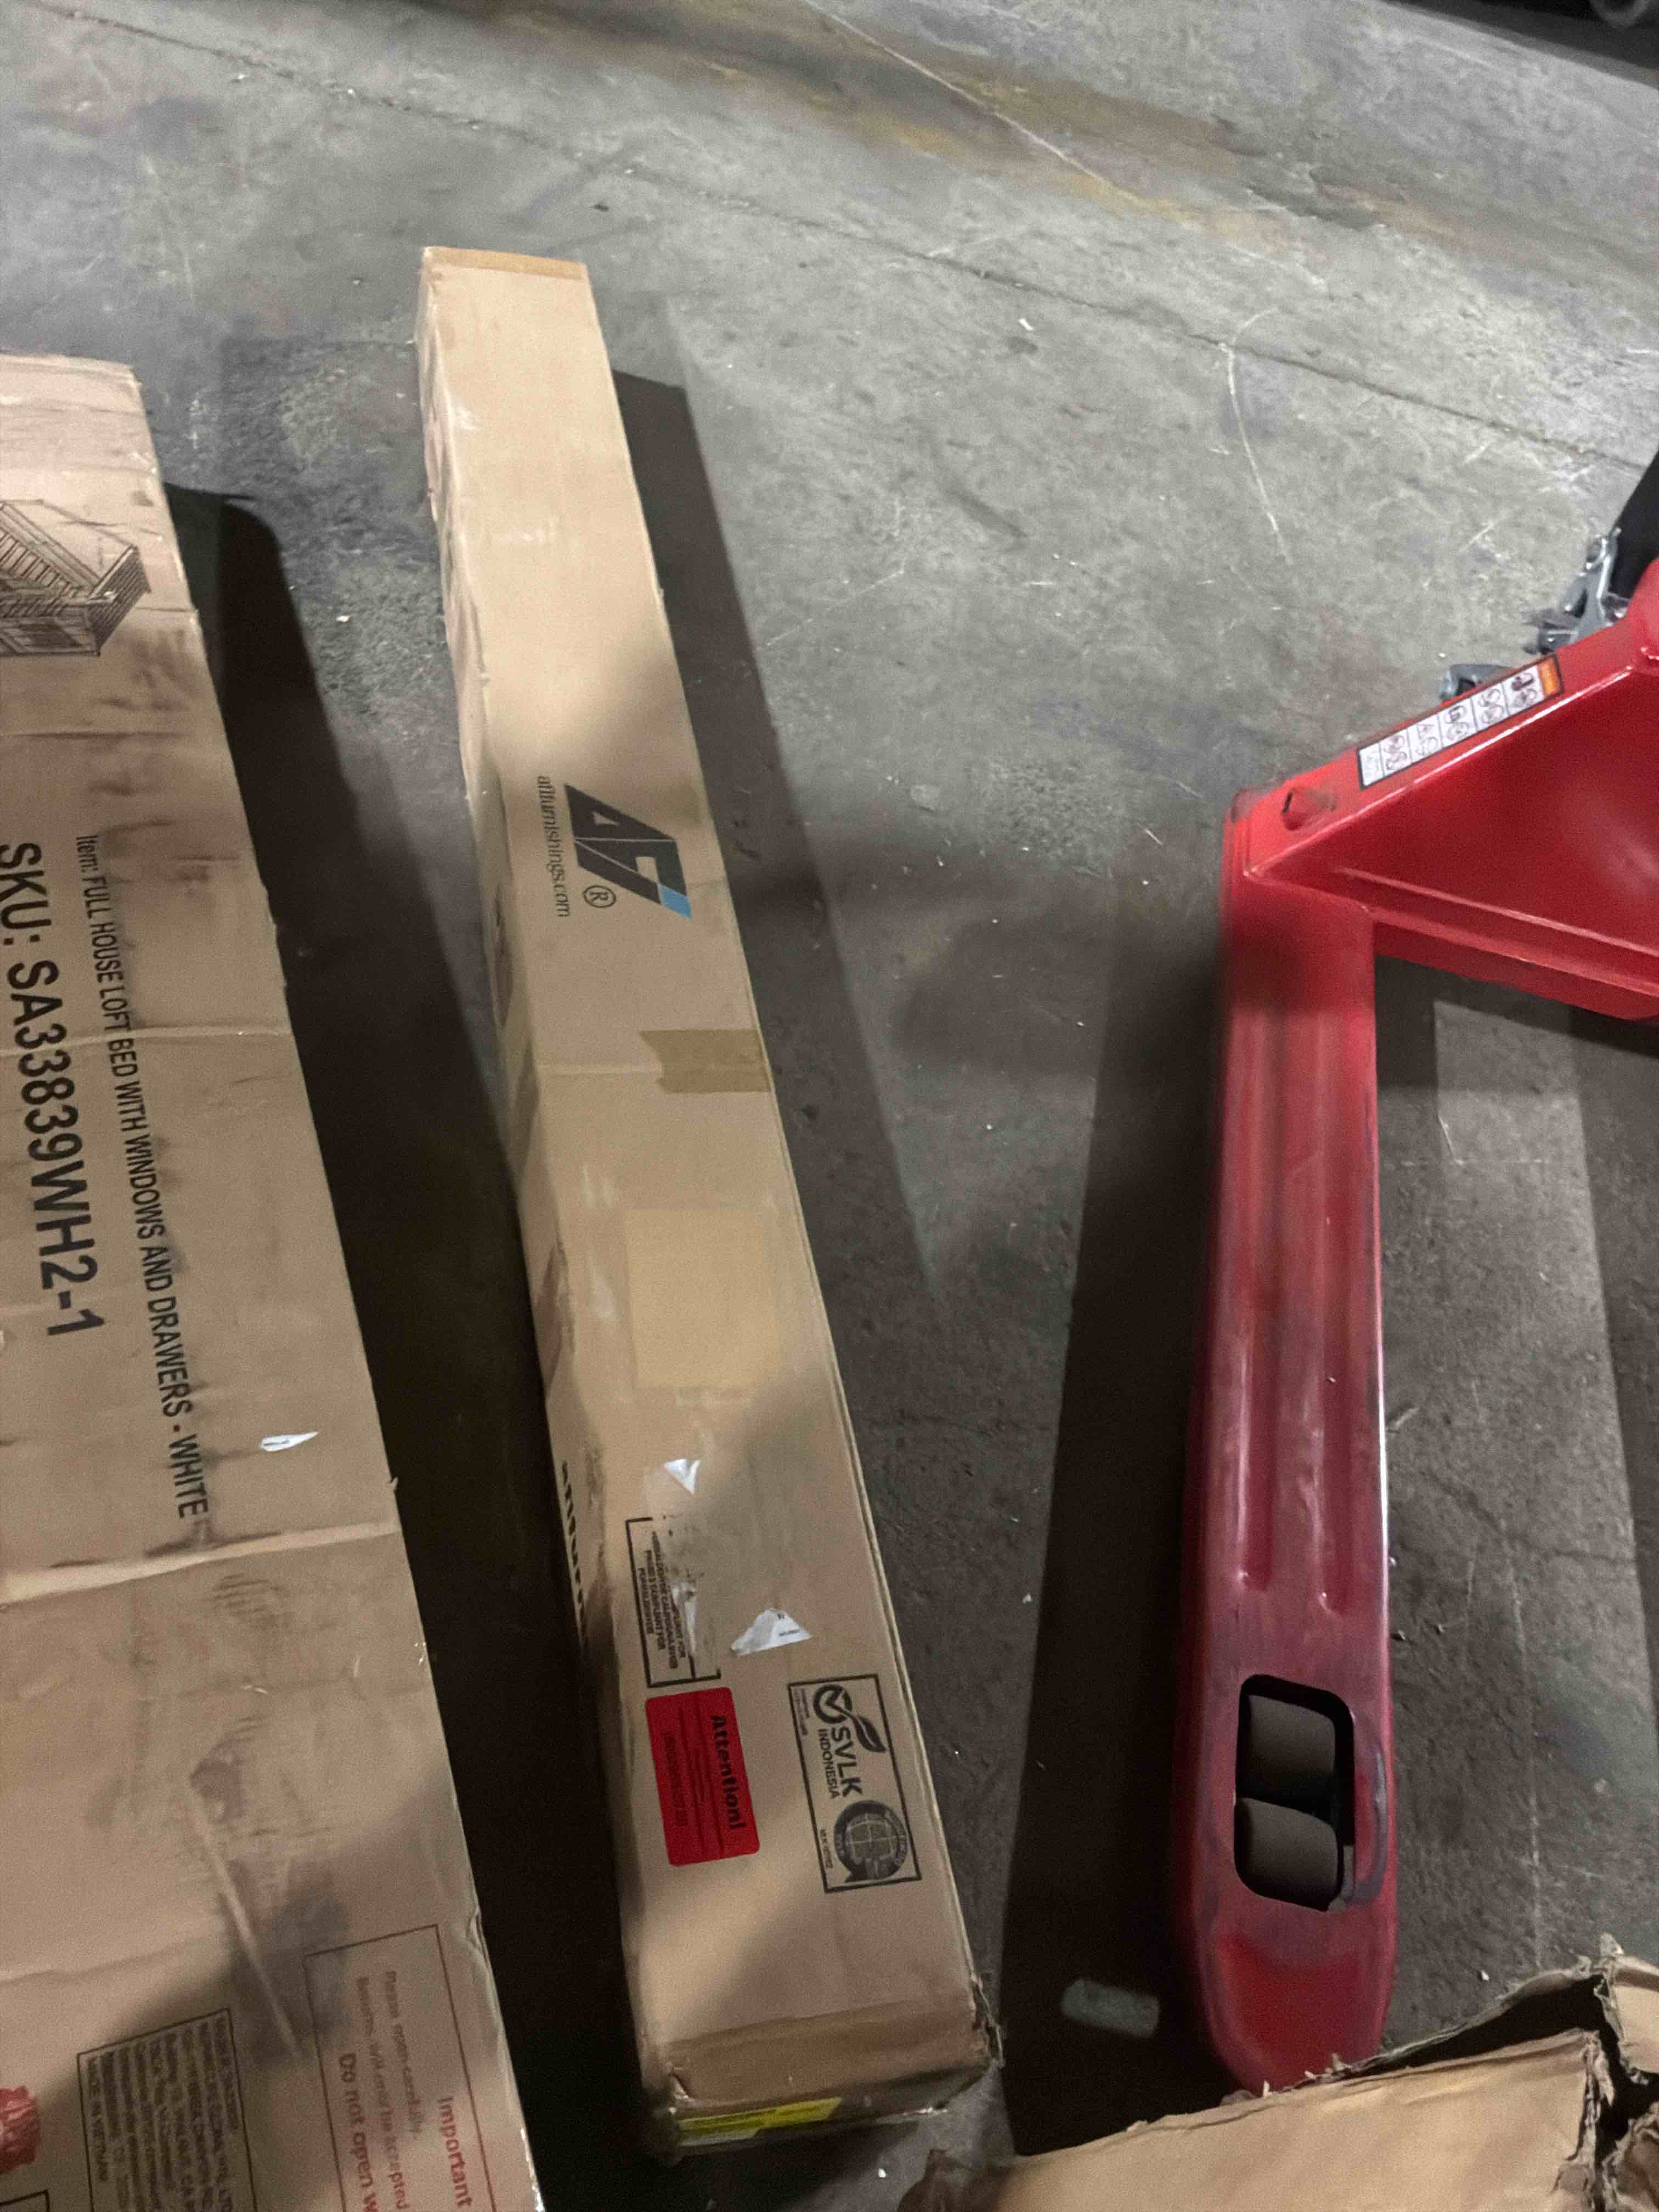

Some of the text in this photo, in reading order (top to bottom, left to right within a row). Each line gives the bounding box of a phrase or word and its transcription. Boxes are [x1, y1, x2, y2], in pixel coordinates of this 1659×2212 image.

[76, 835, 99, 872] Item:
[81, 877, 111, 919] FULL
[89, 922, 125, 984] HOUSE
[99, 986, 132, 1032] LOFT
[108, 1037, 138, 1077] BED
[0, 842, 105, 1336] SKU: SA33839WH2-1
[114, 1081, 149, 1132] WITH
[125, 1133, 165, 1240] WINDOWS
[140, 1246, 173, 1292] AND
[148, 1296, 193, 1417] DRAWERS
[168, 1433, 208, 1519] WHITE
[711, 1715, 746, 1829] Attention!
[818, 1729, 840, 1799] INDONESIA
[832, 1726, 863, 1797] SVLK
[339, 2053, 357, 2084] Do
[345, 2089, 365, 2125] not
[351, 2132, 374, 2188] open
[384, 2134, 410, 2210] accepted
[438, 2097, 473, 2208] Important
